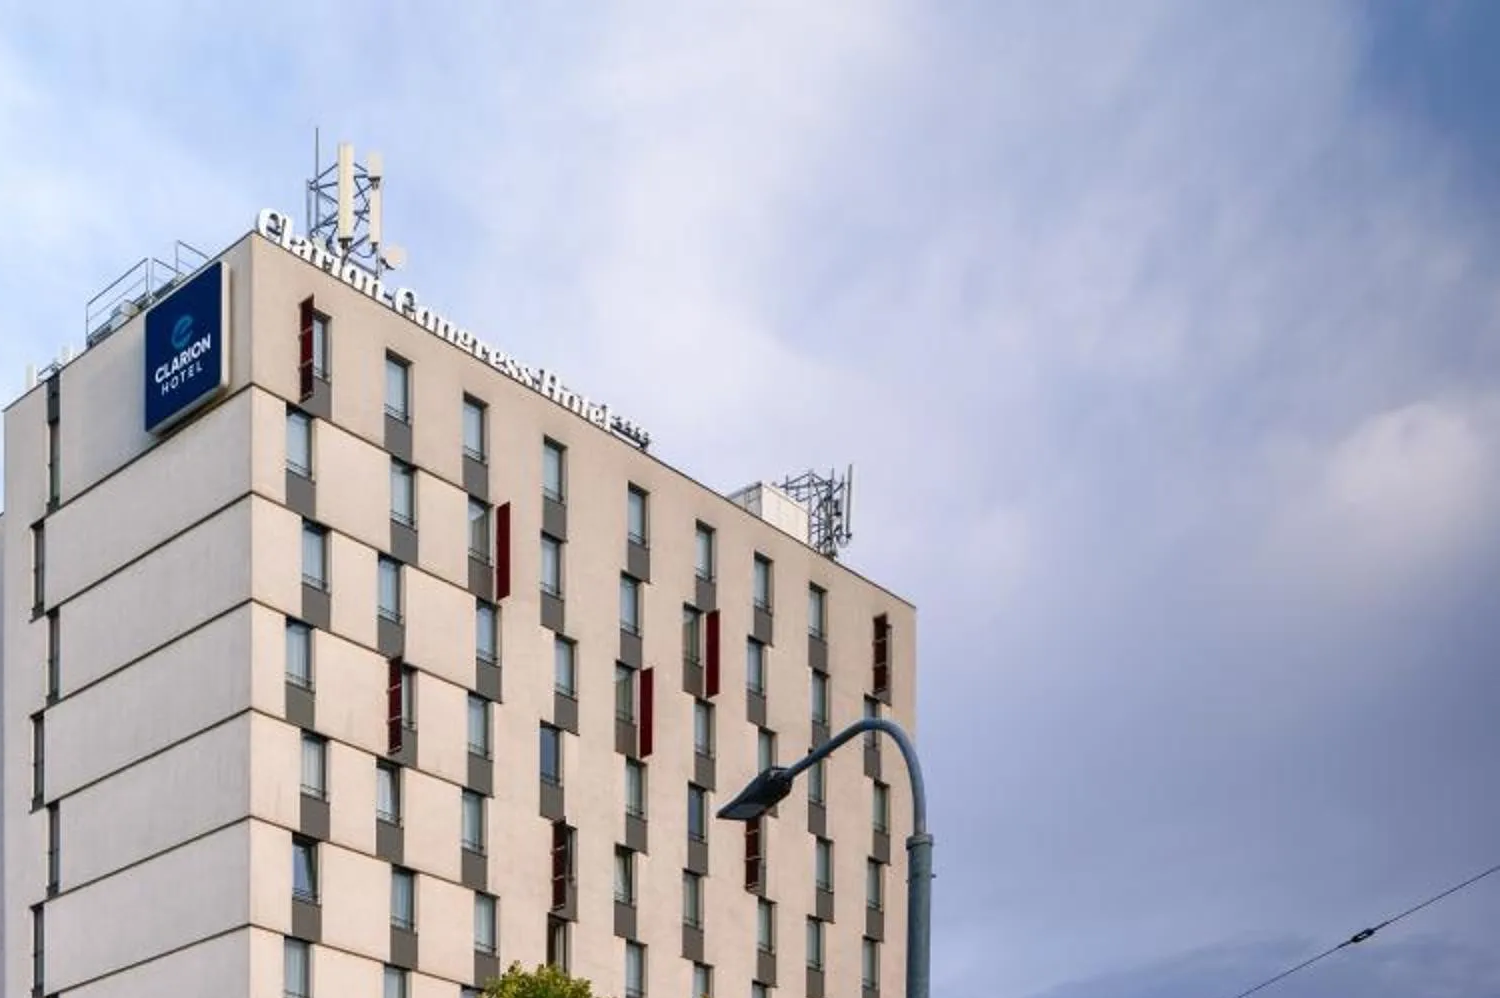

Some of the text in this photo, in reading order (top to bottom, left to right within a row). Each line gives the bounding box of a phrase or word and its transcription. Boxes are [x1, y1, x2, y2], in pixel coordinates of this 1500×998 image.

[257, 207, 613, 433] Clarion Congress Hotel
[155, 332, 211, 384] CLARION
[161, 360, 203, 396] HOTEL
